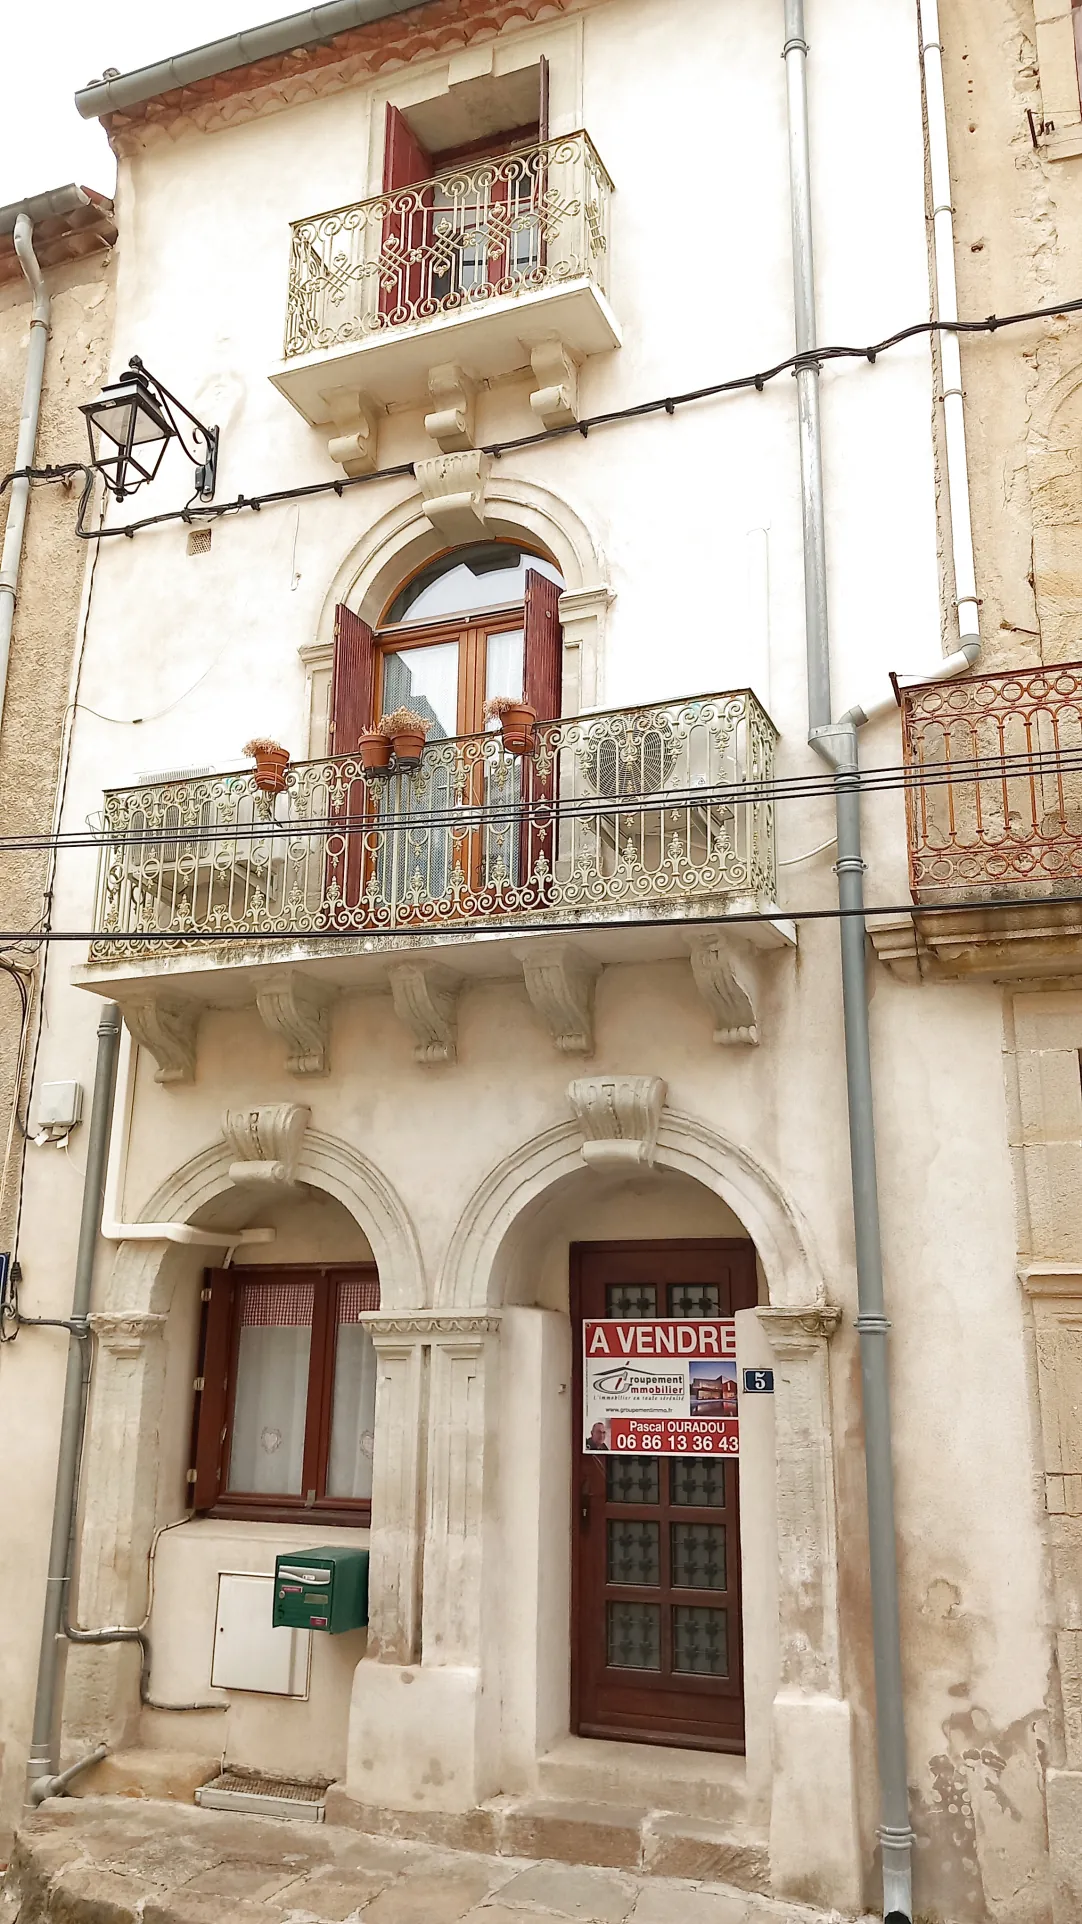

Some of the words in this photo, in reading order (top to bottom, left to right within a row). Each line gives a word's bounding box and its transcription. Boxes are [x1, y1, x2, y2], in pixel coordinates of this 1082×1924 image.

[589, 1326, 610, 1353] A
[616, 1326, 736, 1353] VENDRE
[755, 1372, 766, 1389] 5
[629, 1421, 665, 1432] Pascal
[667, 1421, 725, 1433] OURADOU
[617, 1434, 637, 1449] 06
[642, 1435, 662, 1449] 86
[668, 1435, 687, 1450] 13
[692, 1435, 713, 1450] 36
[718, 1436, 739, 1451] 43
